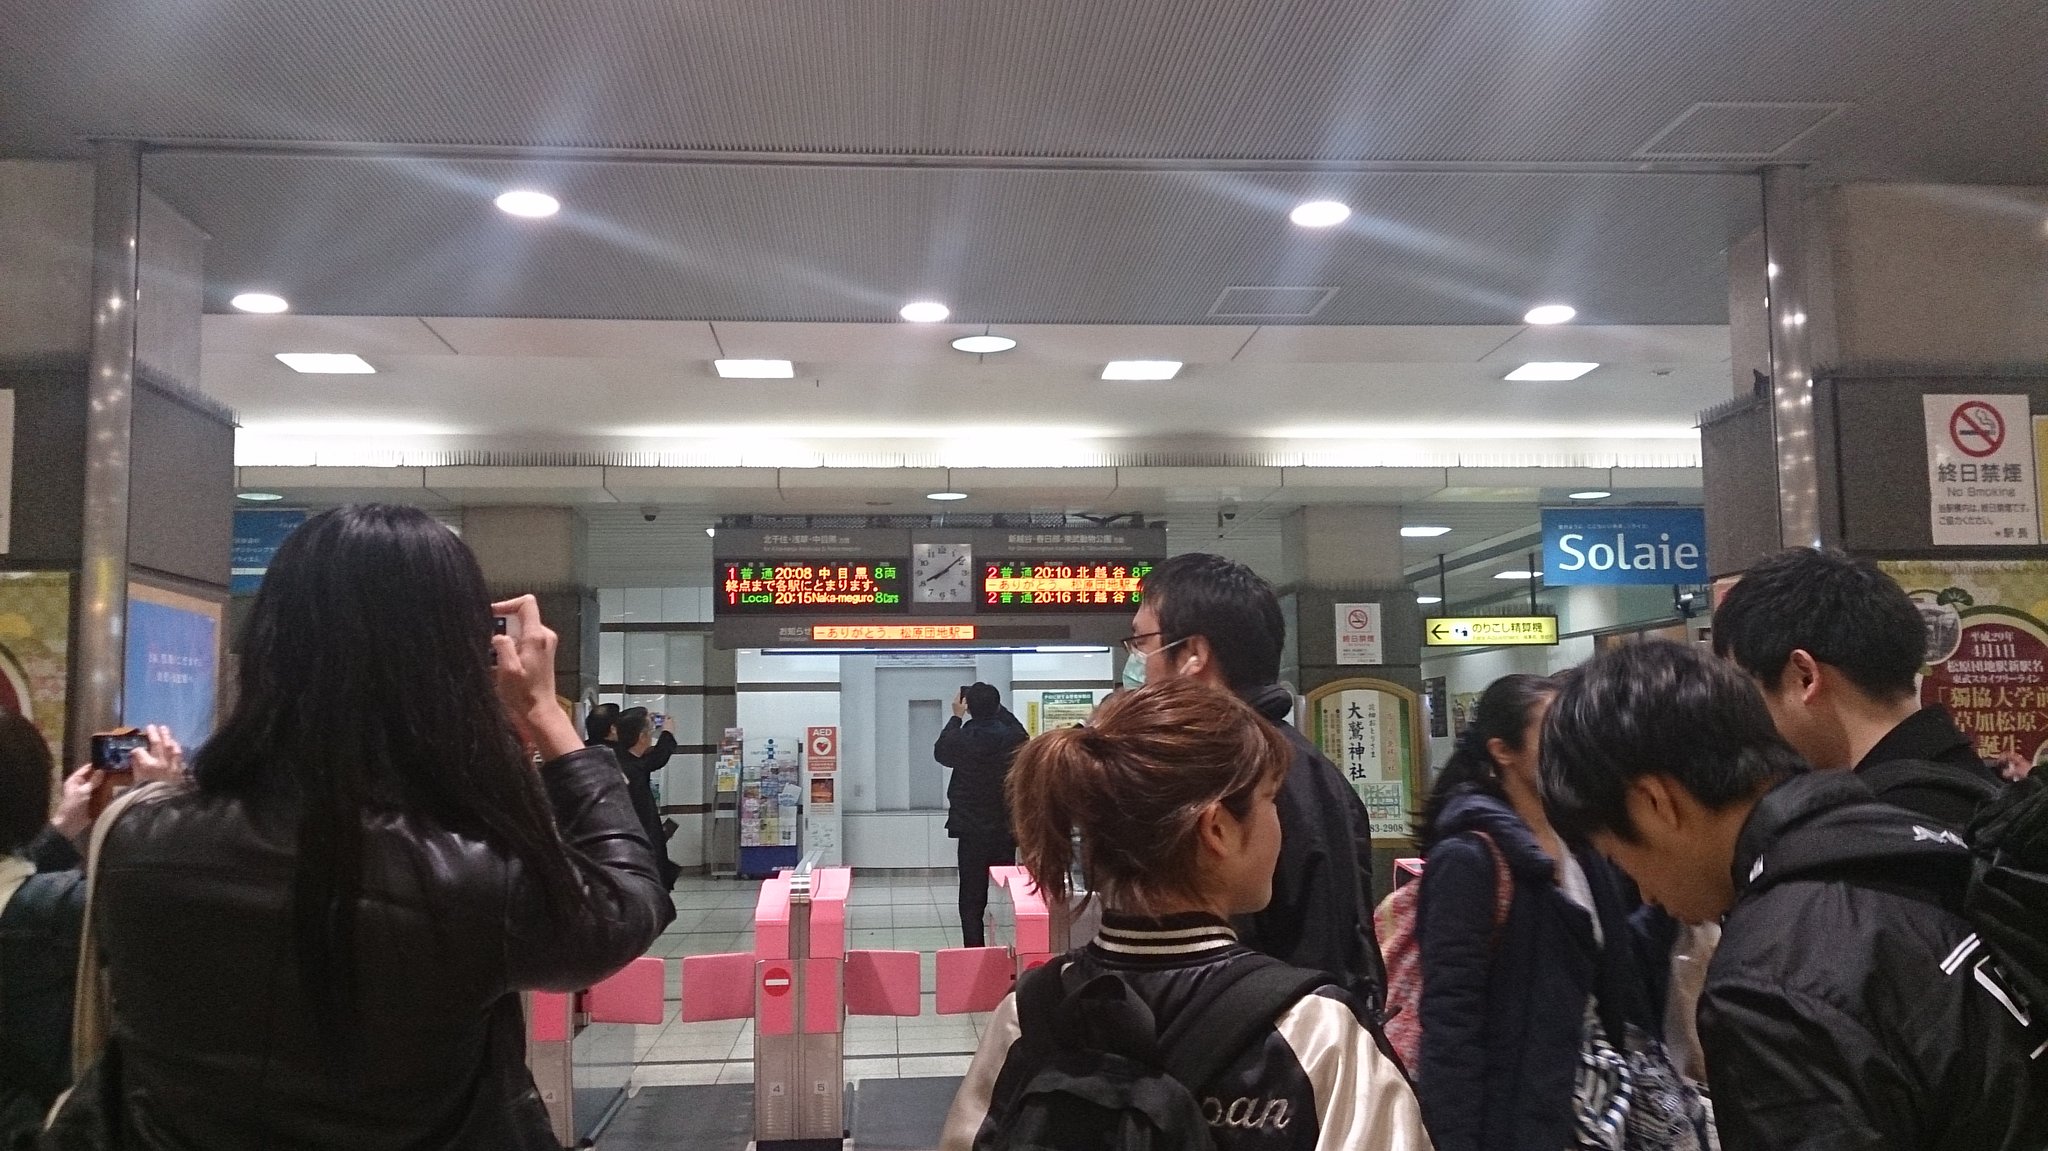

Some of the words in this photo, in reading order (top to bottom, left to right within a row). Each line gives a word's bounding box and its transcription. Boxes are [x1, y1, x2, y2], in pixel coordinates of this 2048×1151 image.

[1938, 463, 2022, 482] 終日禁煙
[1947, 487, 1963, 497] No
[1968, 486, 2016, 498] Smoking
[1559, 533, 1699, 571] Solaie
[728, 568, 736, 580] 1
[740, 568, 773, 580] 普通
[775, 568, 812, 580] 20:08
[818, 567, 868, 580] 中目黒
[987, 567, 998, 579] 2
[1001, 567, 1033, 579] 普通
[1034, 567, 1072, 579] 20:10
[1076, 567, 1126, 579] 北越谷
[725, 580, 879, 592] 終点まで各駅にとまります。
[728, 593, 736, 604] 1
[742, 593, 772, 603] Local
[775, 592, 812, 604] 20:15
[812, 593, 874, 605] Naka-meguro
[987, 592, 998, 604] 2
[1001, 592, 1033, 604] 普通
[1034, 592, 1072, 604] 20:16
[1076, 592, 1126, 604] 北越谷
[1472, 623, 1543, 633] のりこし精算機
[1971, 631, 2014, 642] 平成29年
[1947, 659, 2044, 673] 松原団地駅新駅名
[1348, 702, 1367, 781] 大鷲神社
[1978, 734, 2022, 759] 誕生
